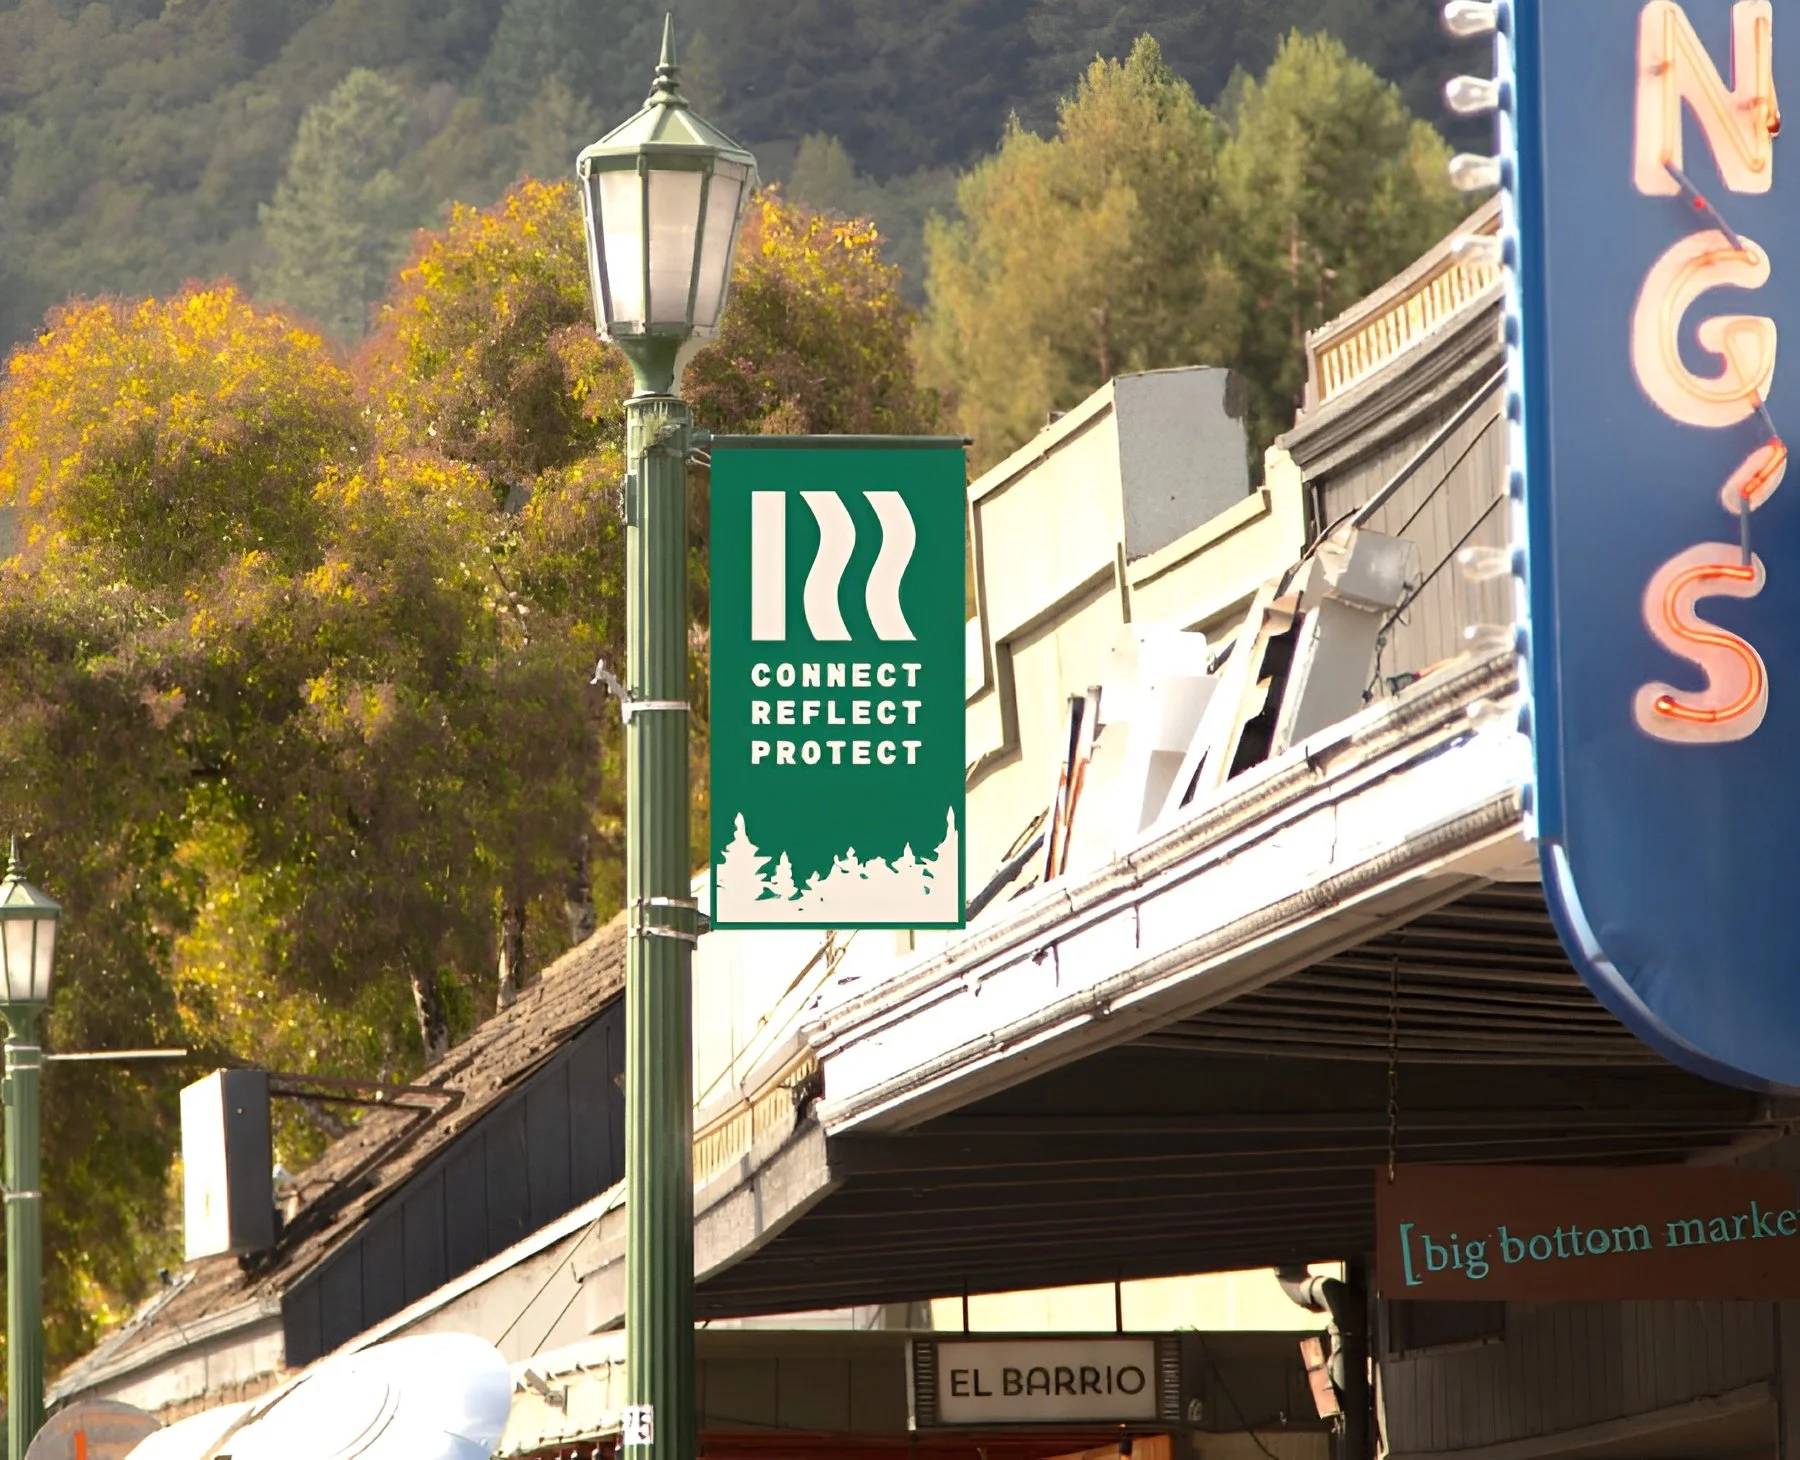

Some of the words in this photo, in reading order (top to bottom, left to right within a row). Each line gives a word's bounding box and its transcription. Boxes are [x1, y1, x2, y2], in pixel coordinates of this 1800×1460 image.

[751, 662, 922, 688] CONNECT
[751, 700, 922, 725] REFLECT
[751, 740, 922, 765] PROTECT
[1499, 1223, 1652, 1264] bottom
[1667, 1201, 1800, 1247] marke
[950, 1368, 992, 1397] EL
[1002, 1366, 1146, 1396] BARRIO
